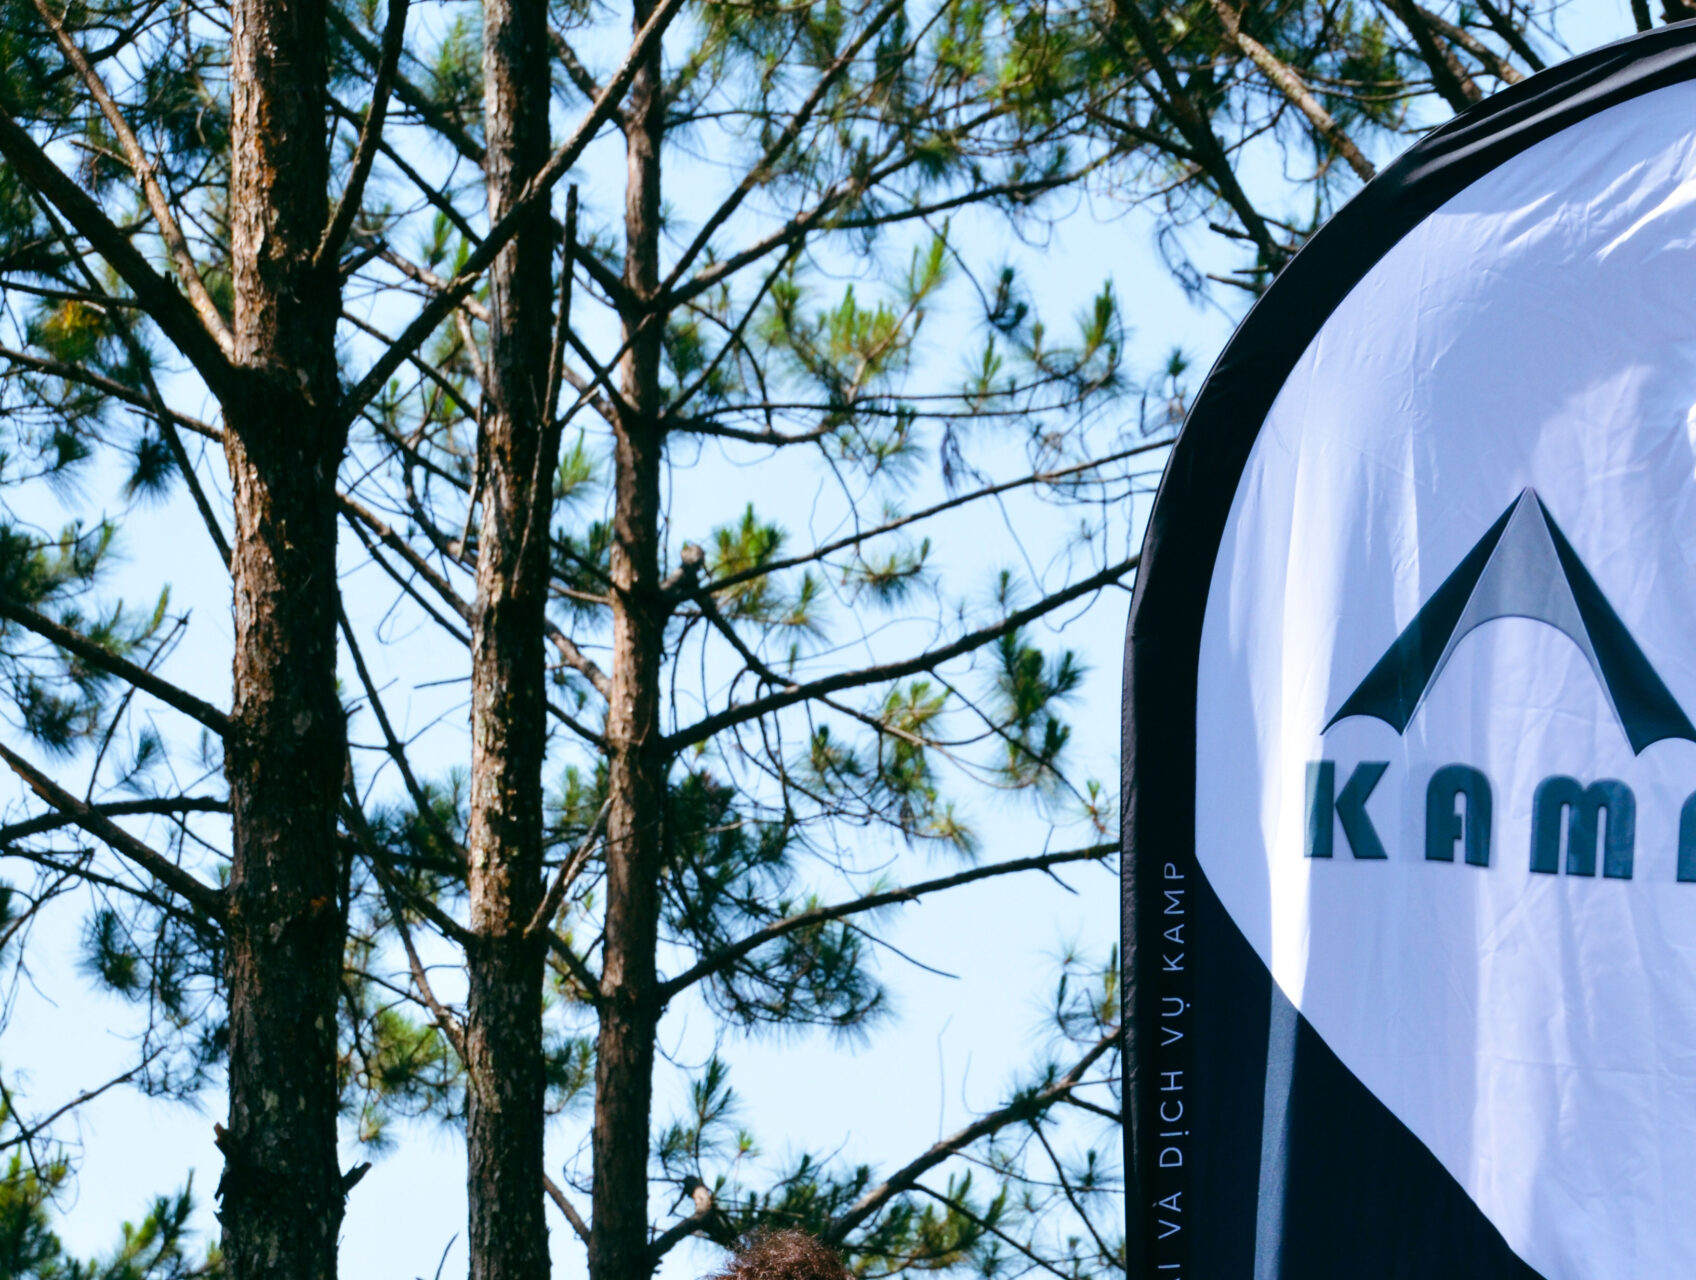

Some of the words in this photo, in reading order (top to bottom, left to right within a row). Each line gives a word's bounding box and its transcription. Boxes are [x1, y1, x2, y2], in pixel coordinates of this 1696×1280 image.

[1162, 862, 1185, 972] KAMP
[1161, 996, 1191, 1047] VỤ
[1159, 1070, 1190, 1168] DỊCH
[1153, 1191, 1183, 1240] VÀ
